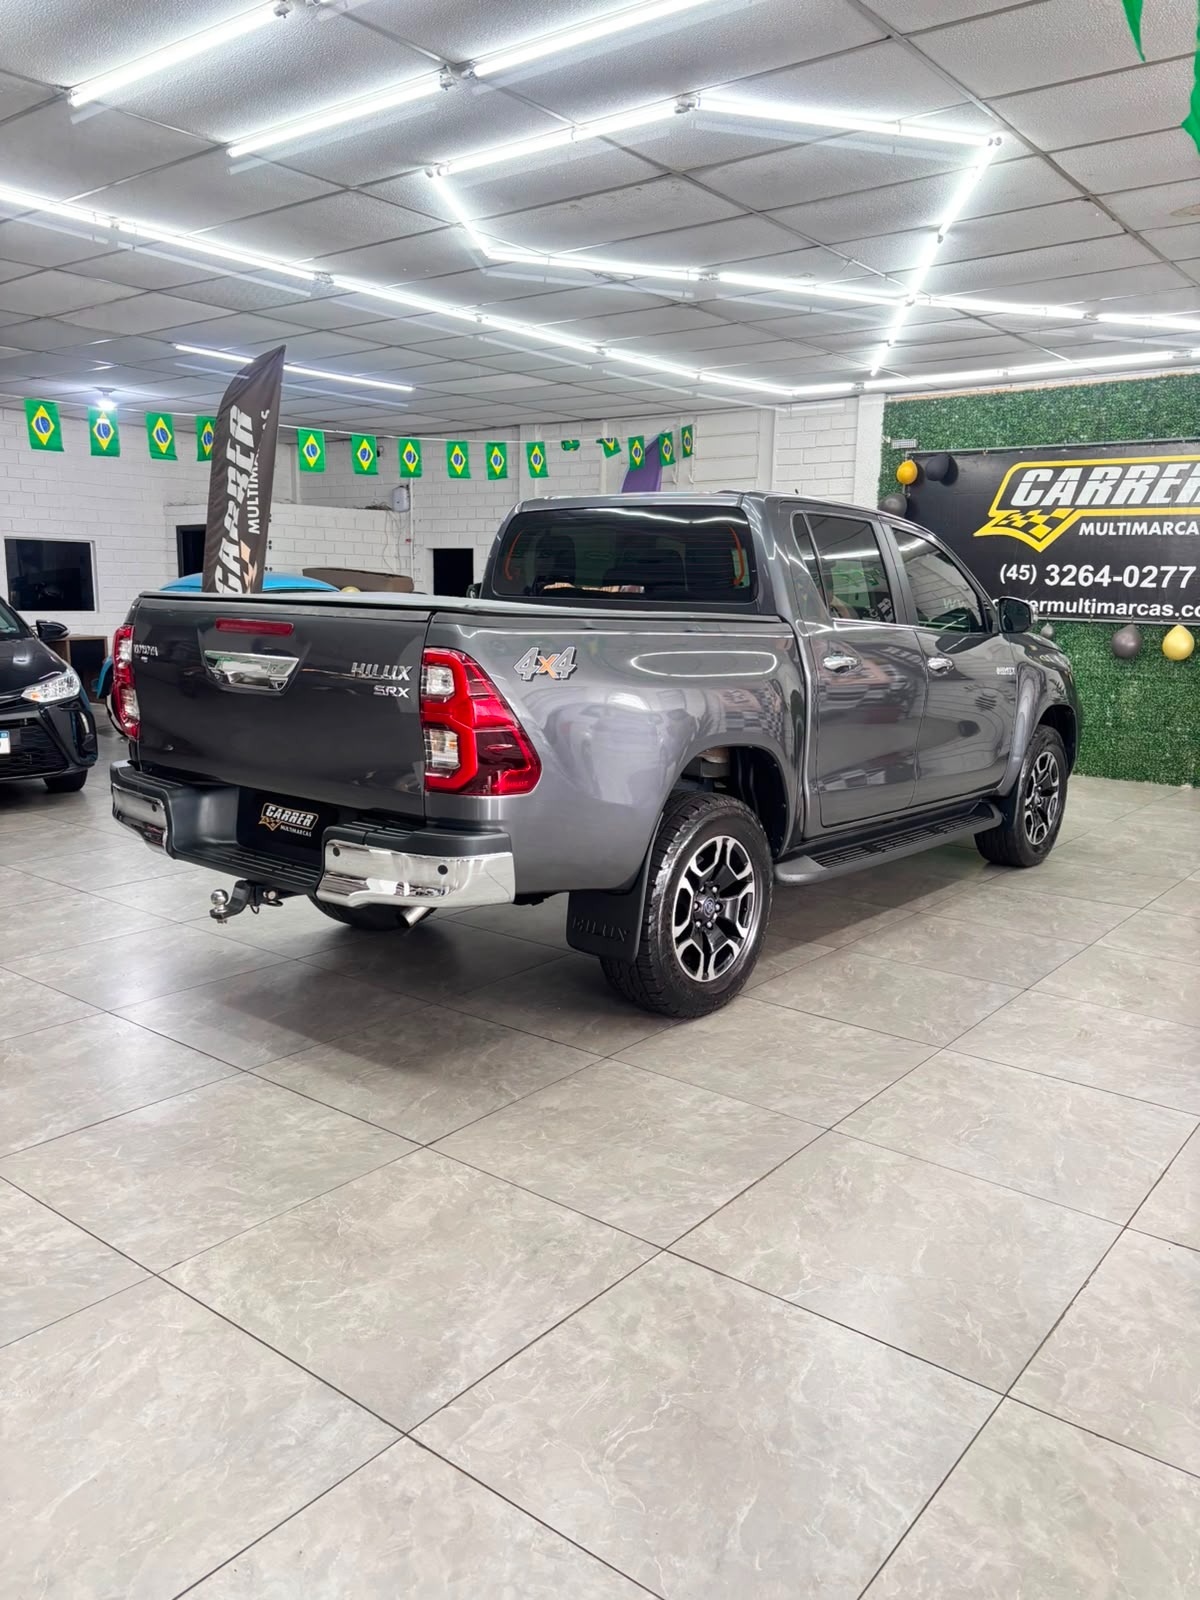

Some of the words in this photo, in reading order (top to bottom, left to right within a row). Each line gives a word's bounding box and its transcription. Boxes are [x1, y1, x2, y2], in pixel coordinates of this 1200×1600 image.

[1000, 563, 1037, 585] (45)
[1044, 564, 1197, 589] 3264-0277
[351, 661, 413, 681] HILUX
[514, 646, 578, 681] 4x4
[373, 684, 411, 699] SRX
[265, 805, 315, 827] CARRER
